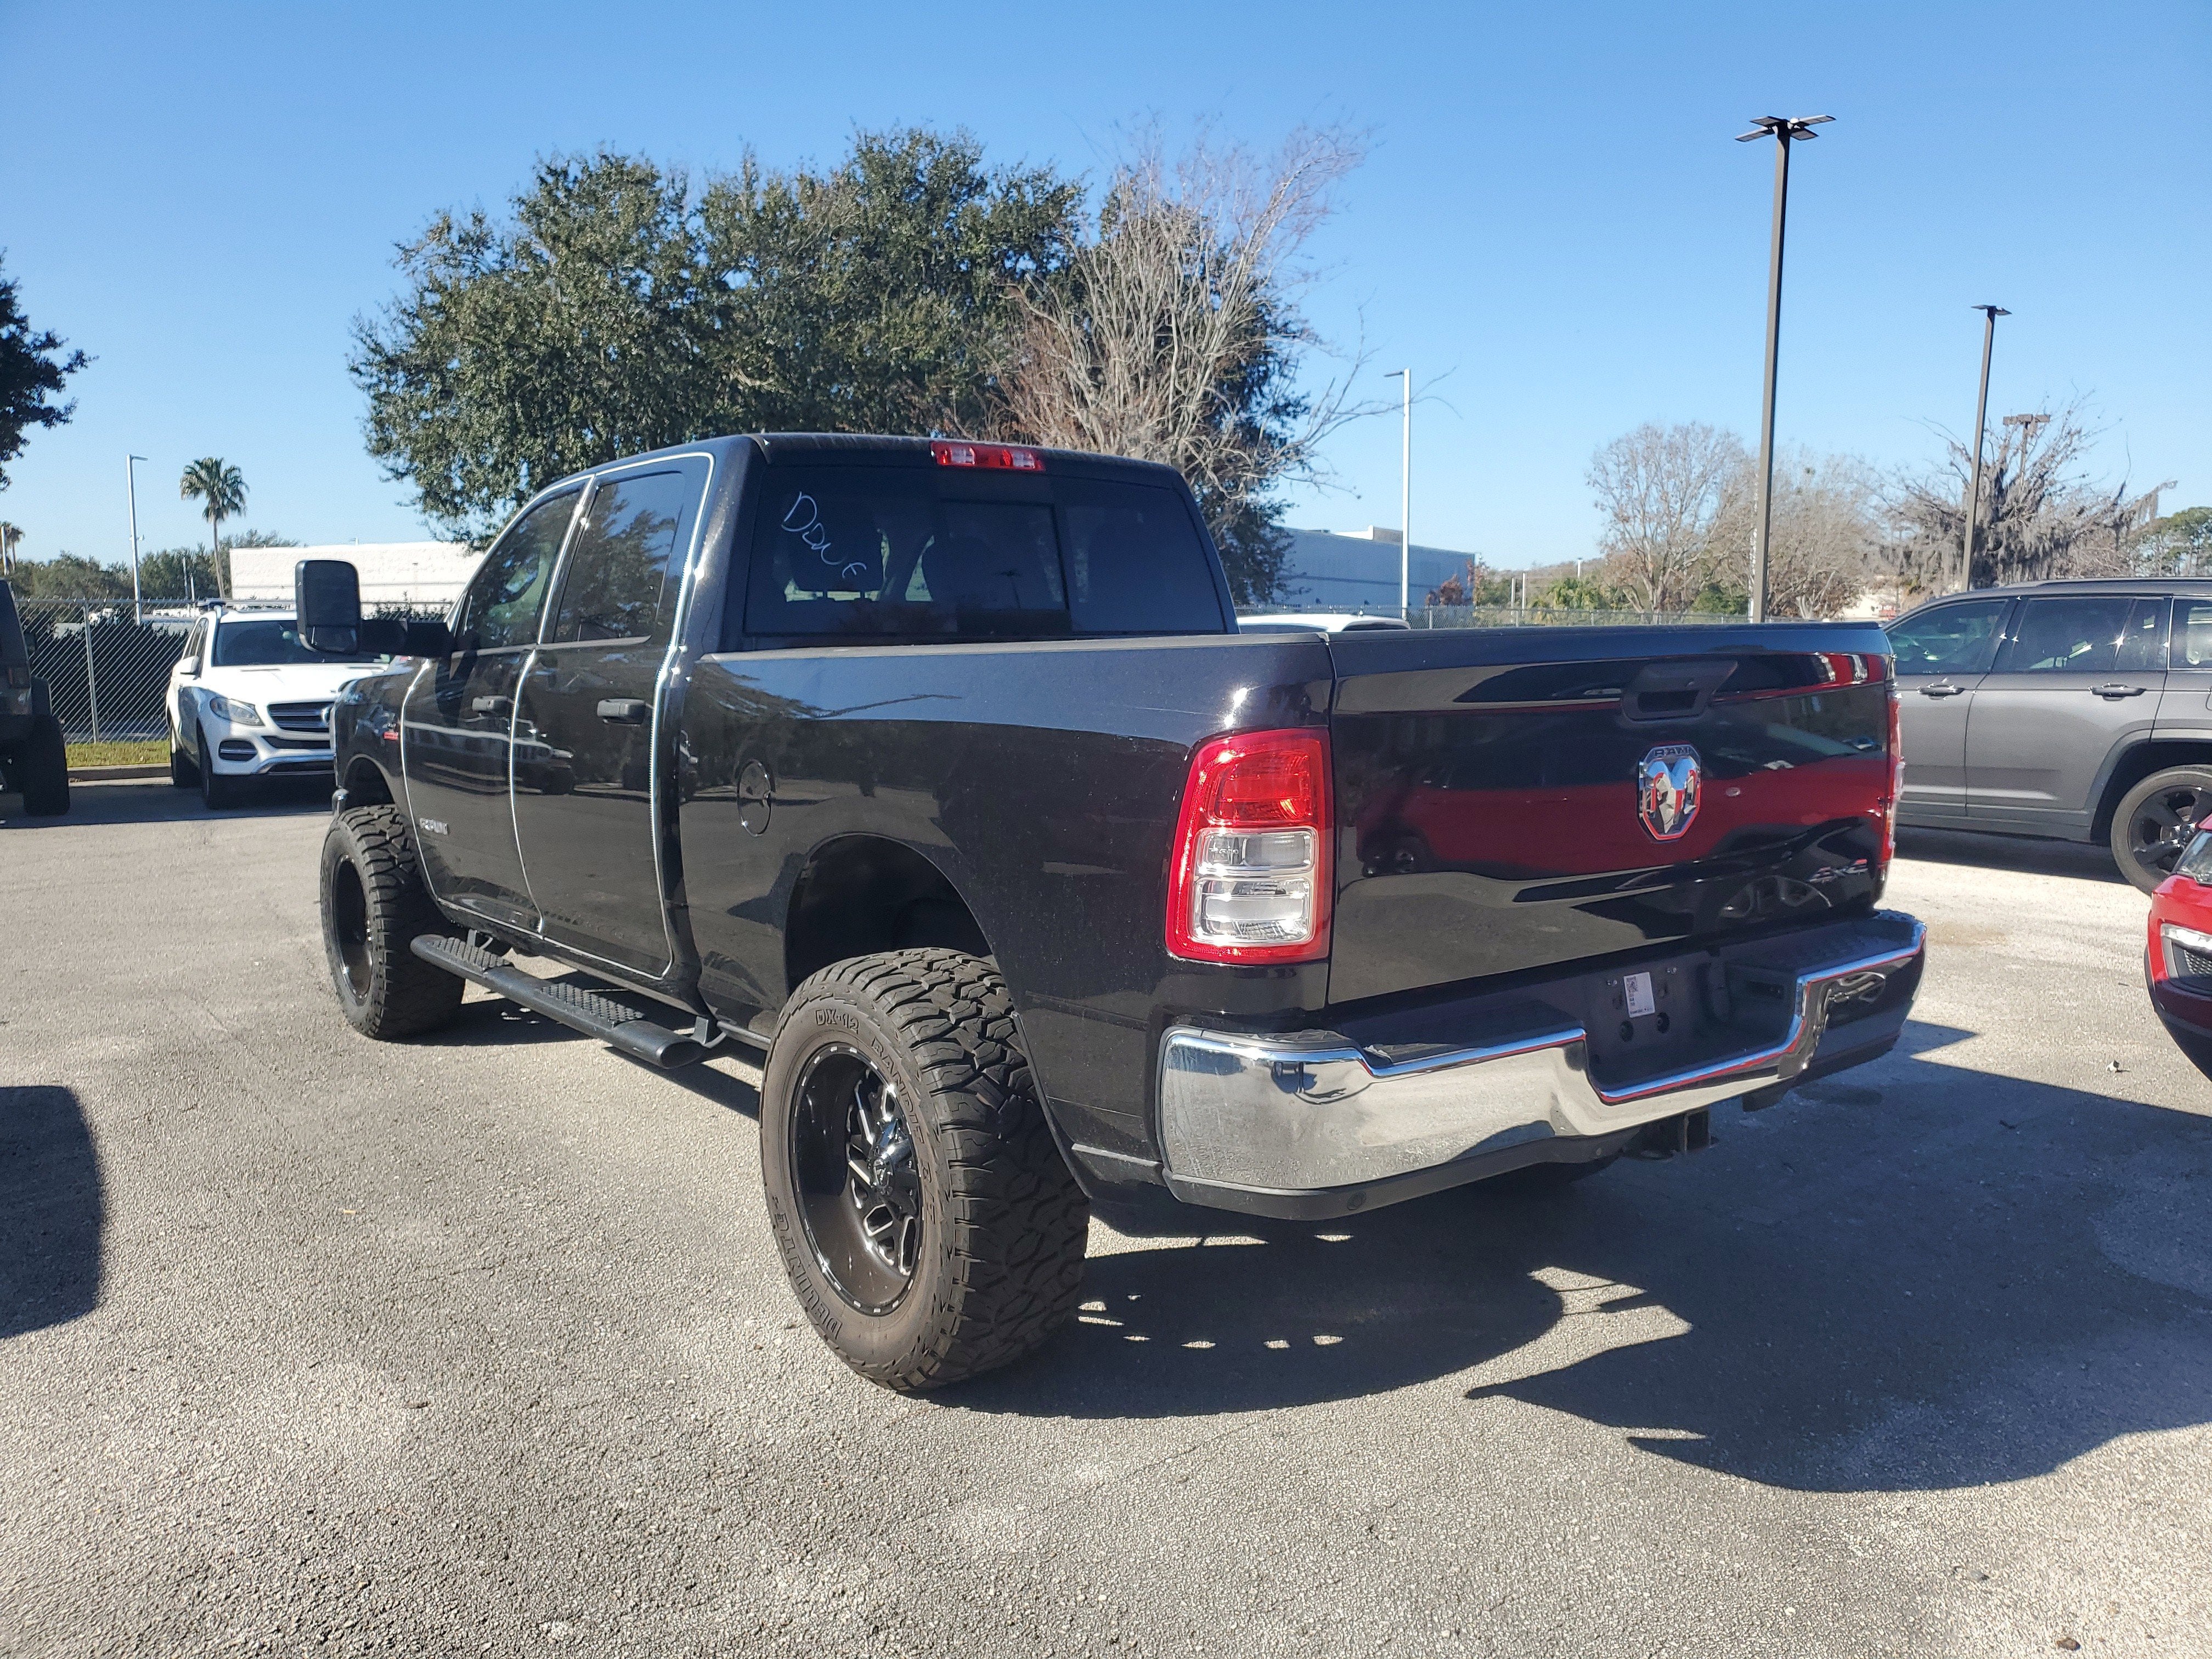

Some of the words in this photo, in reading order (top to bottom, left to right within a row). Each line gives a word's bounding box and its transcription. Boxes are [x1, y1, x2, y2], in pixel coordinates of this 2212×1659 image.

[1654, 747, 1689, 758] RAM
[815, 1008, 859, 1034] DX-12
[774, 1212, 843, 1340] DELINTE
